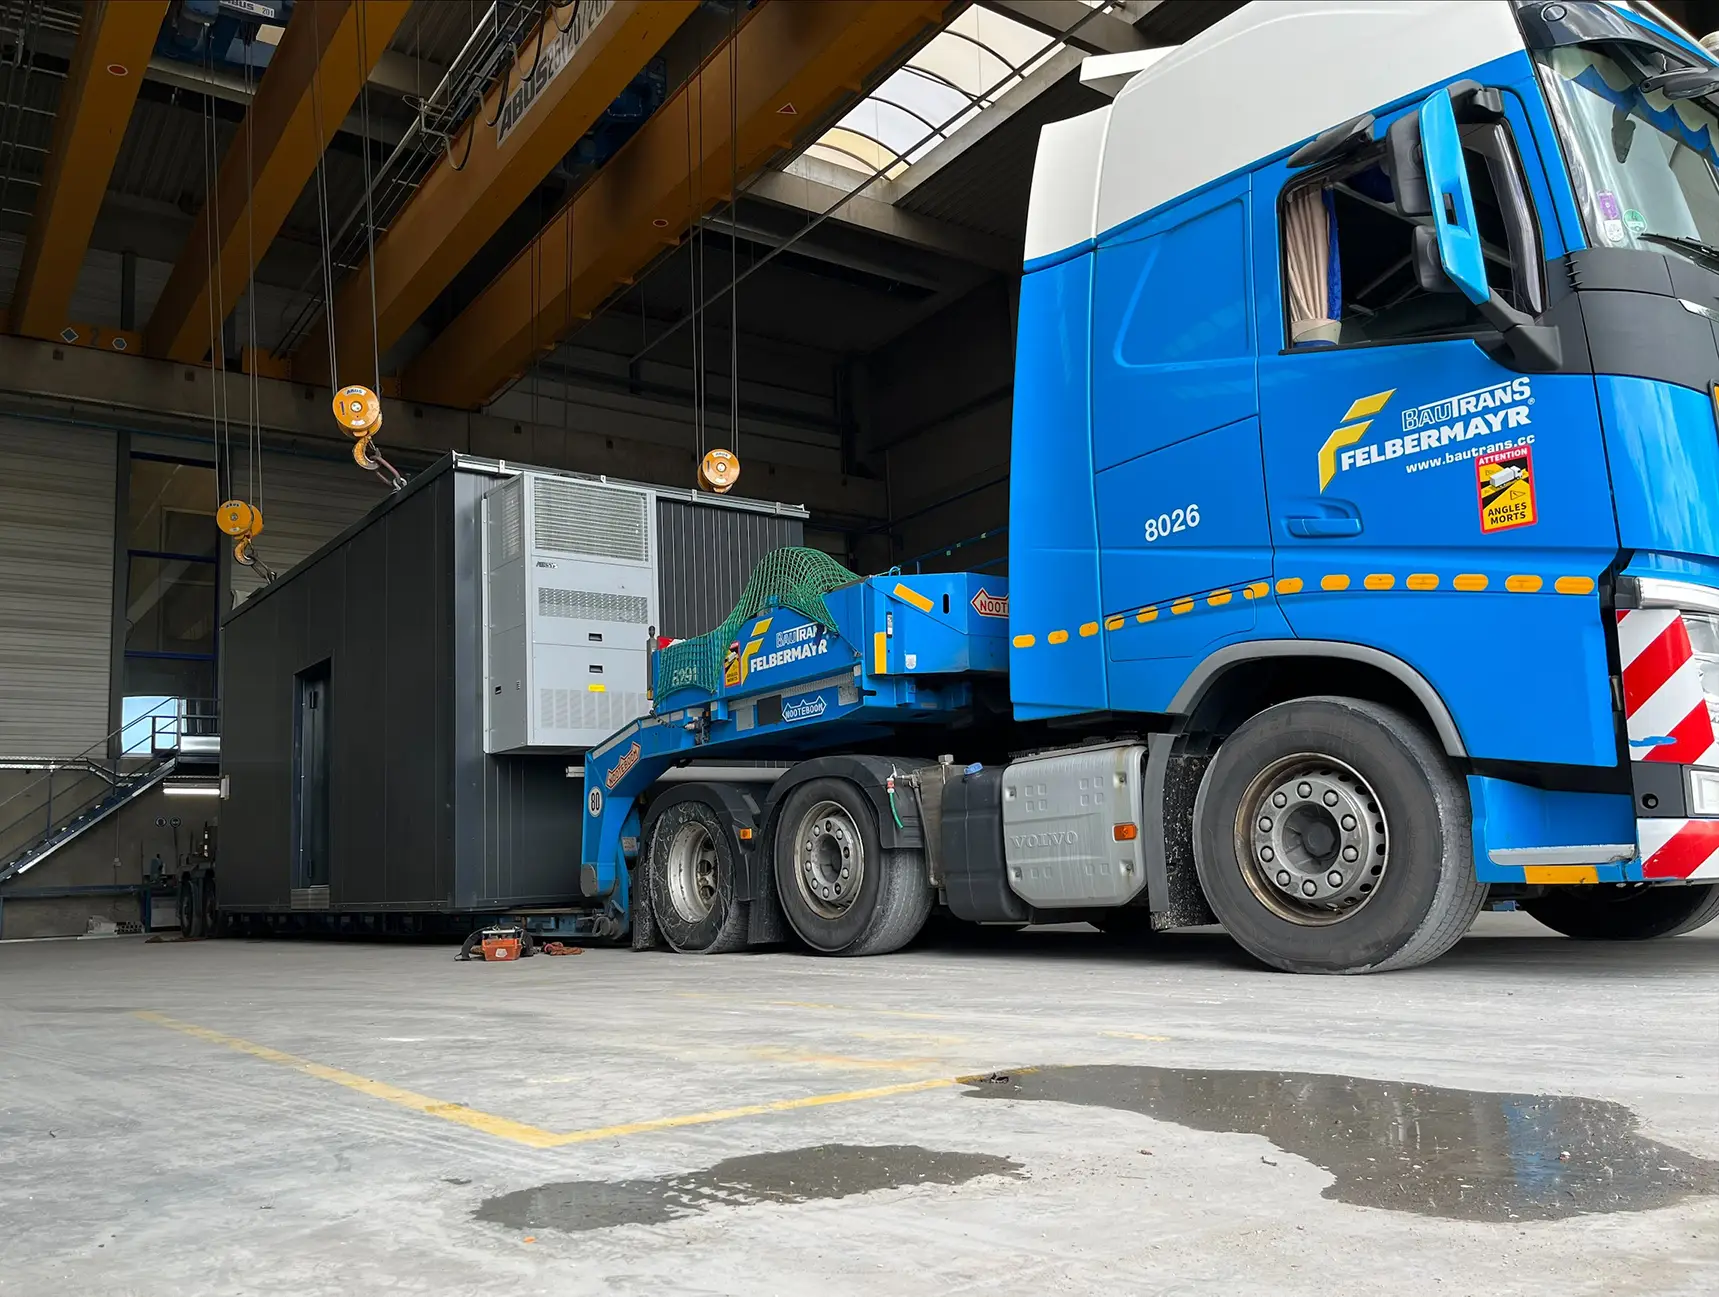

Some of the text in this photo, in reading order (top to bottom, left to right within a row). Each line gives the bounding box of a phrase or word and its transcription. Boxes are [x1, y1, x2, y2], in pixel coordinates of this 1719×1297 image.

[499, 56, 548, 142] ABUS
[339, 400, 345, 416] 1
[1341, 405, 1532, 471] FELBERMAYR
[1405, 434, 1536, 474] www.bautrans.cc
[1478, 447, 1528, 466] ATTENTION
[1488, 502, 1527, 517] ANGLES
[1490, 511, 1526, 525] MORTS
[1144, 503, 1200, 542] 8026
[750, 638, 828, 673] FELBERMAYR
[785, 703, 823, 719] NOOTEBOOM
[590, 791, 600, 811] 80
[1009, 830, 1079, 849] VOLVO
